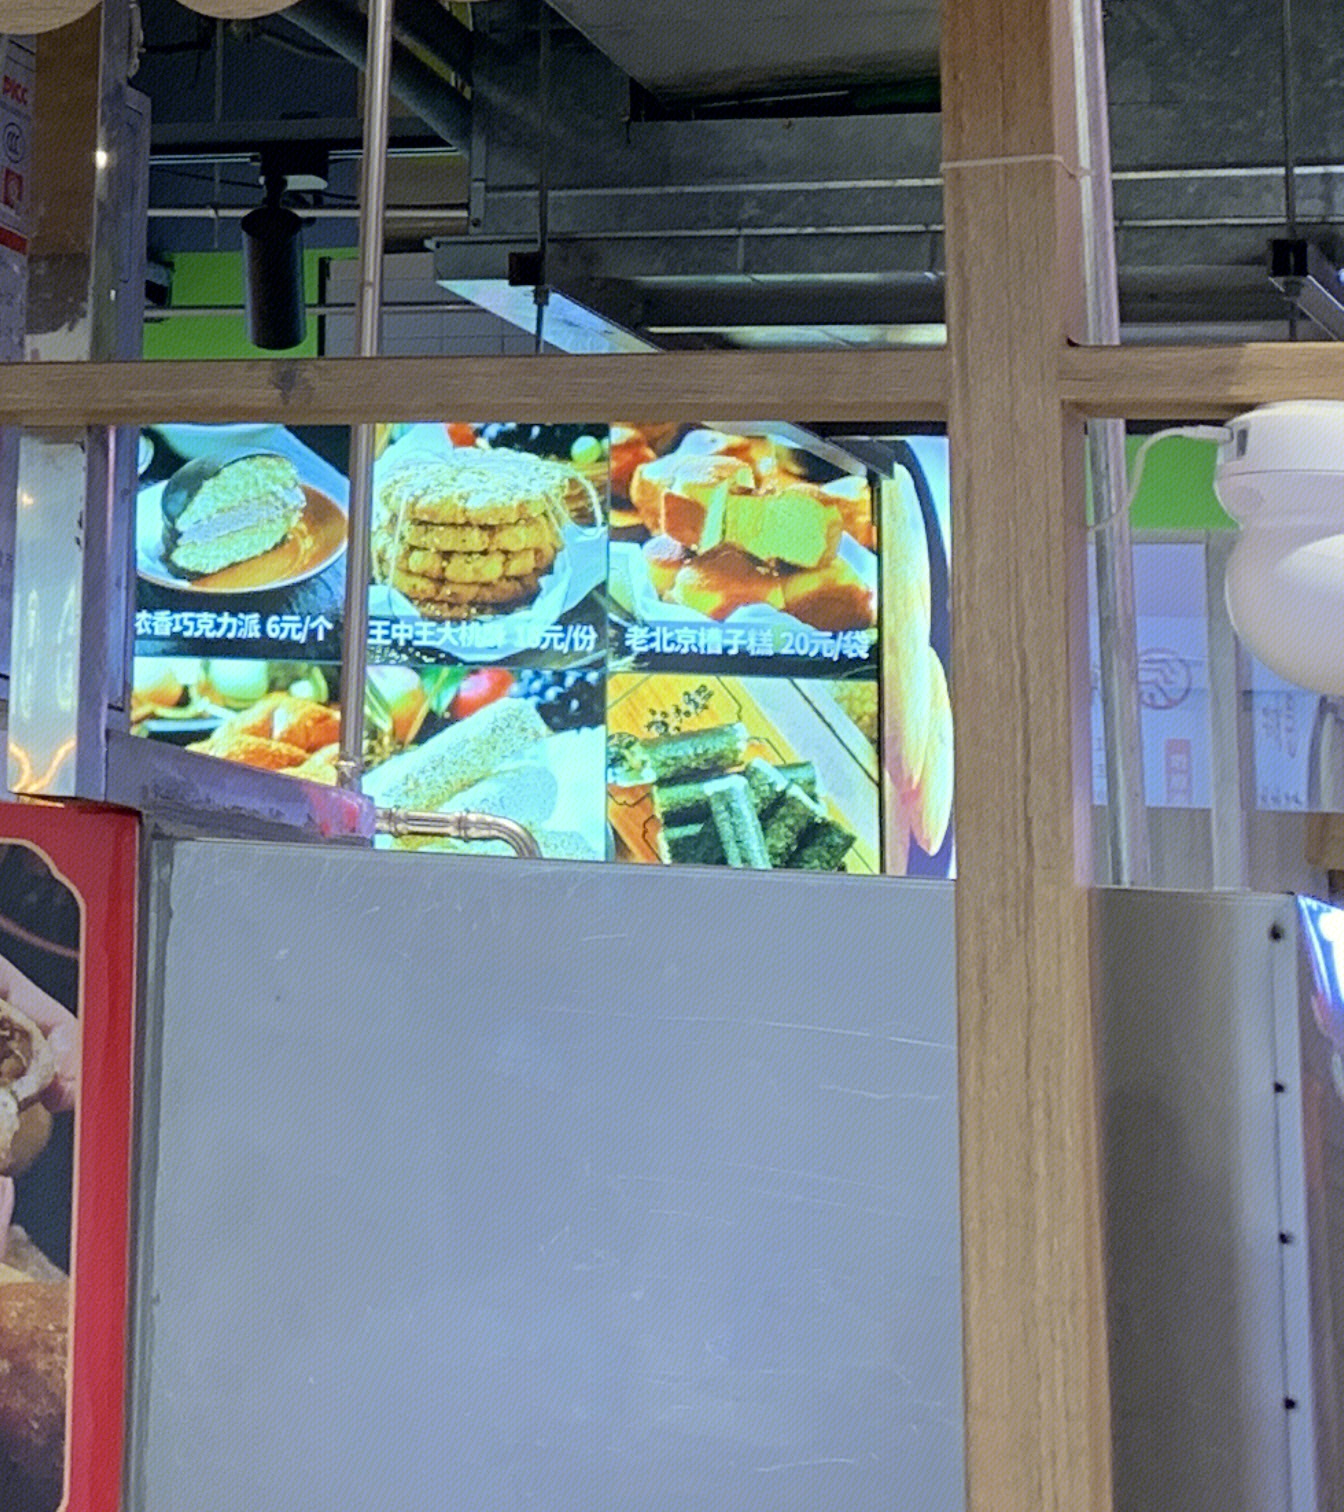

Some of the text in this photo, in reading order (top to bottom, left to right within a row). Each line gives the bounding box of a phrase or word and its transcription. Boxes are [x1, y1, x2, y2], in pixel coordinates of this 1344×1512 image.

[265, 614, 334, 644] 6元/个
[624, 624, 871, 662] 老北京槽子糕 20元/袋
